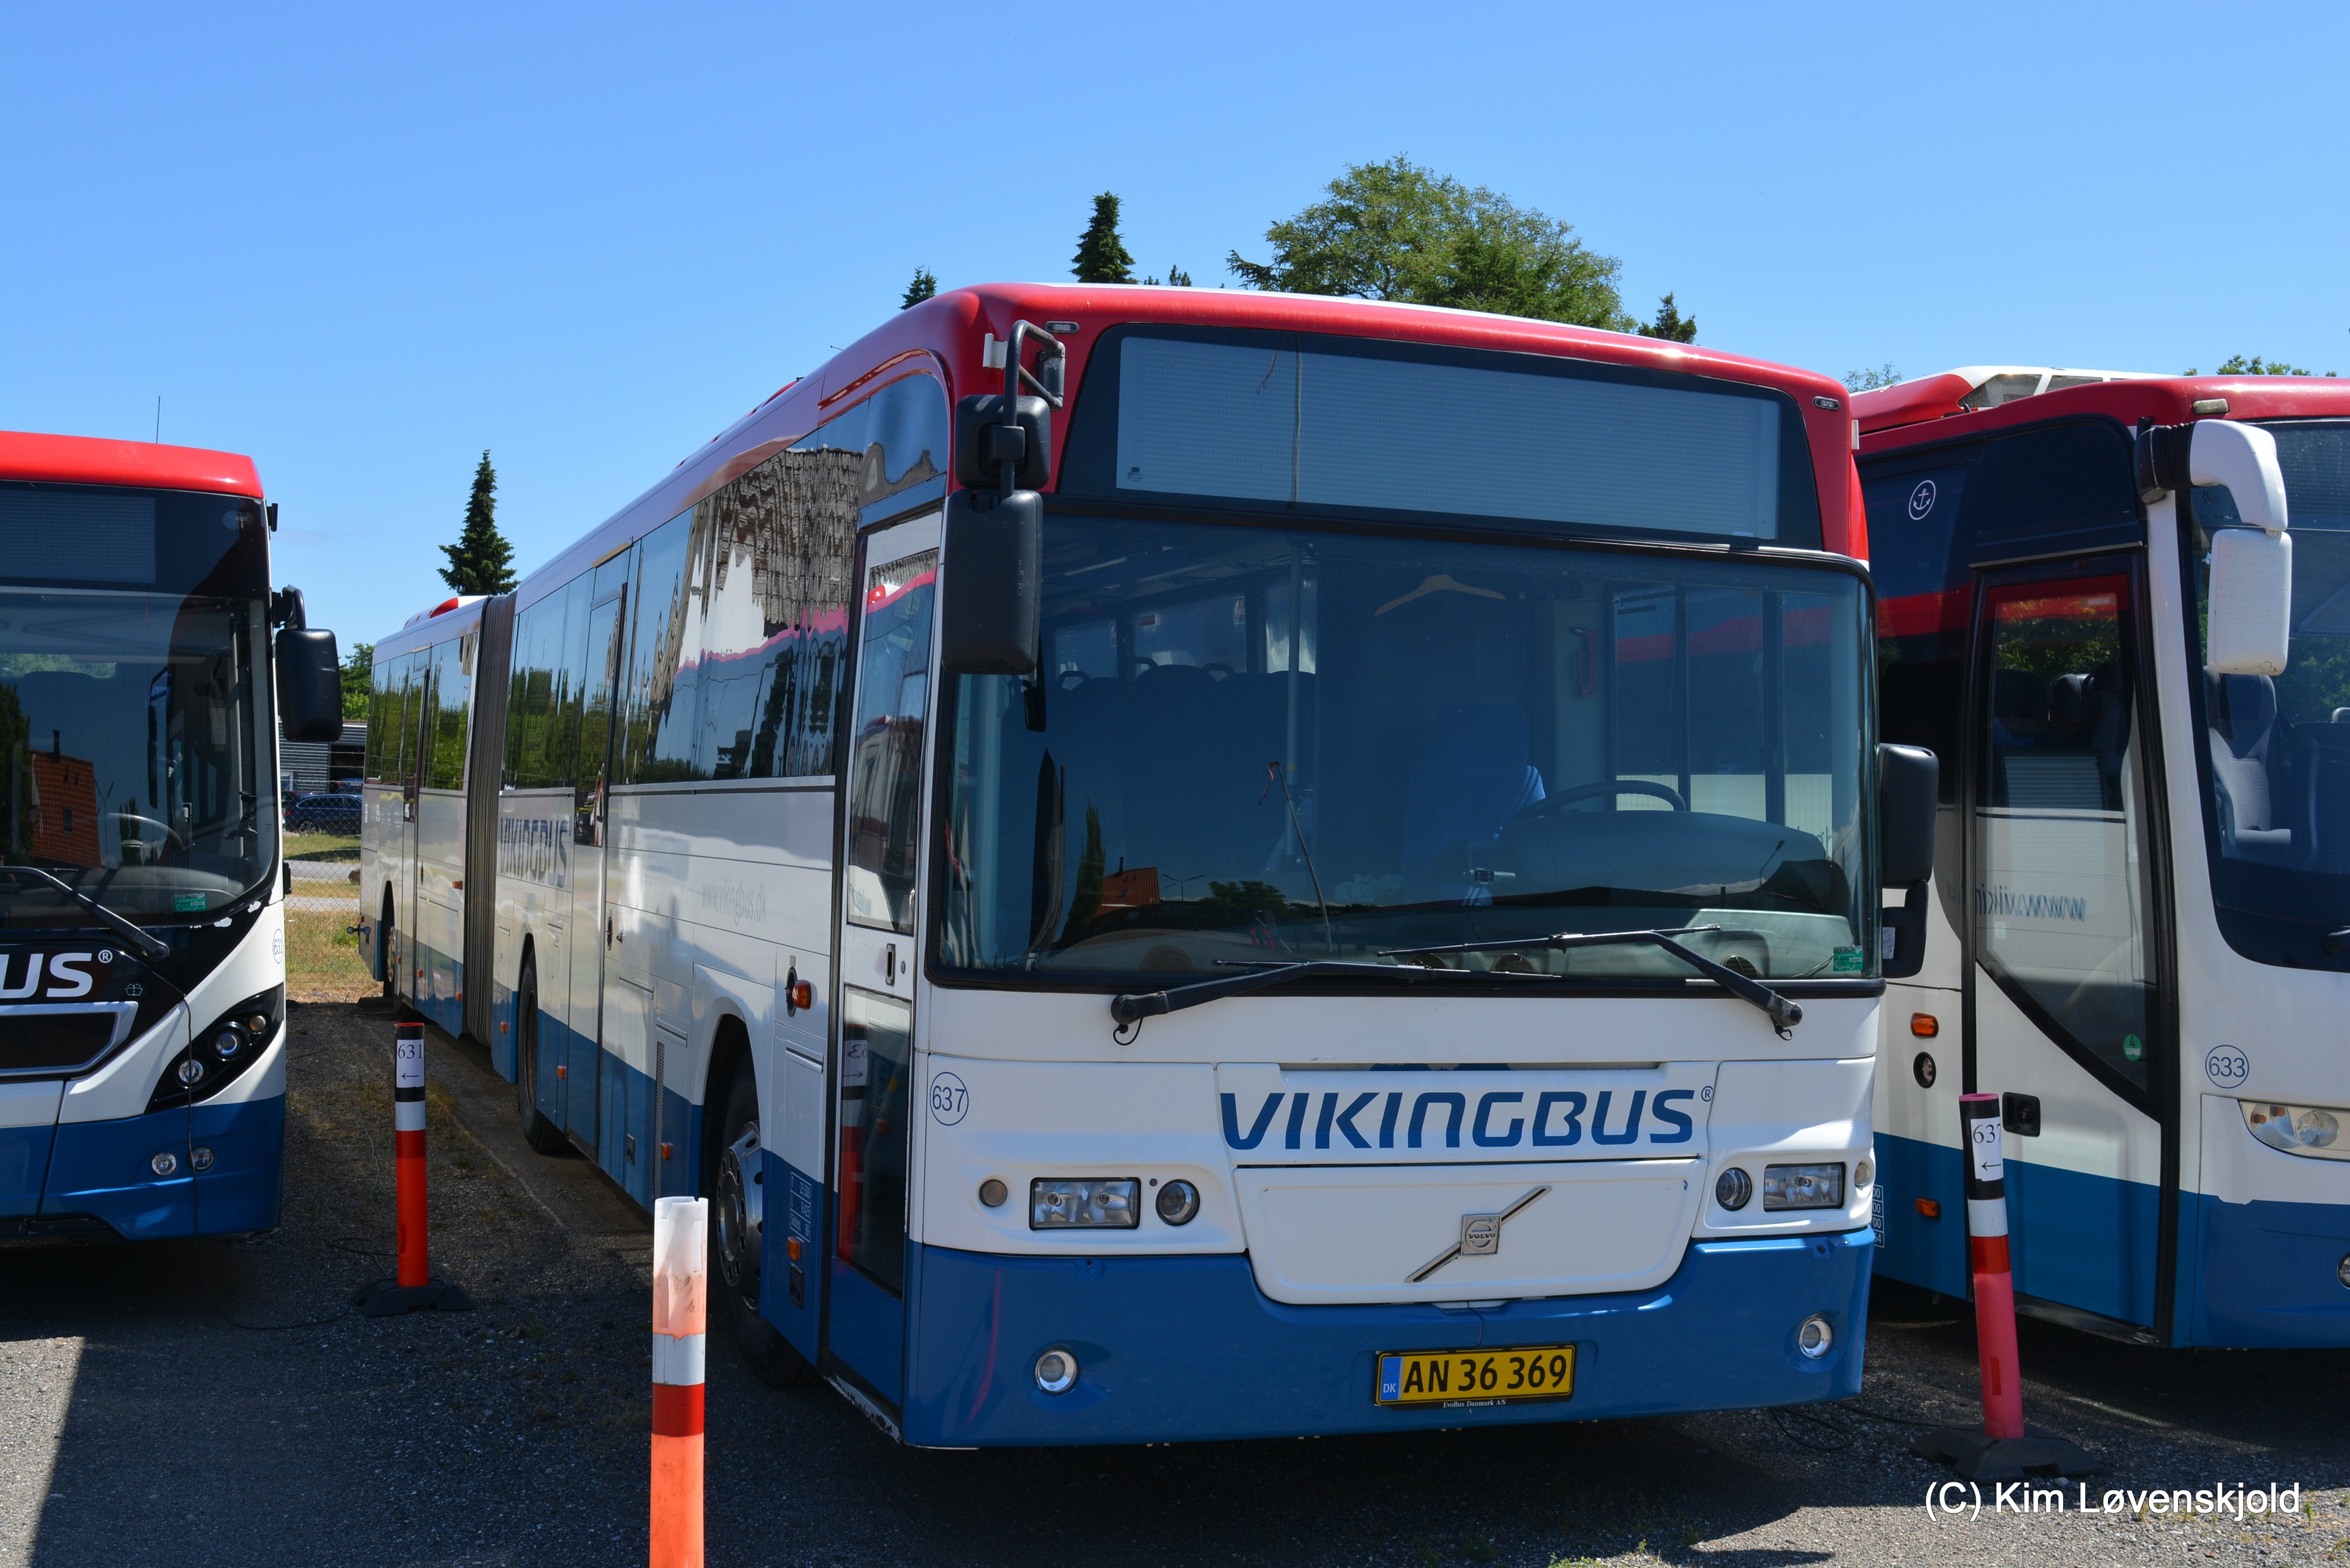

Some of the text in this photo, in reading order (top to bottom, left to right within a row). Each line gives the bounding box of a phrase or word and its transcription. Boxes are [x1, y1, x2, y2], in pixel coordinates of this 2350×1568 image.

[702, 877, 767, 927] www.vikingbus.dk
[398, 1044, 422, 1059] 631
[2130, 1035, 2135, 1048] 4
[2209, 1056, 2245, 1078] 633
[932, 1085, 966, 1113] 637
[1382, 1354, 1567, 1394] DK AN 36 369
